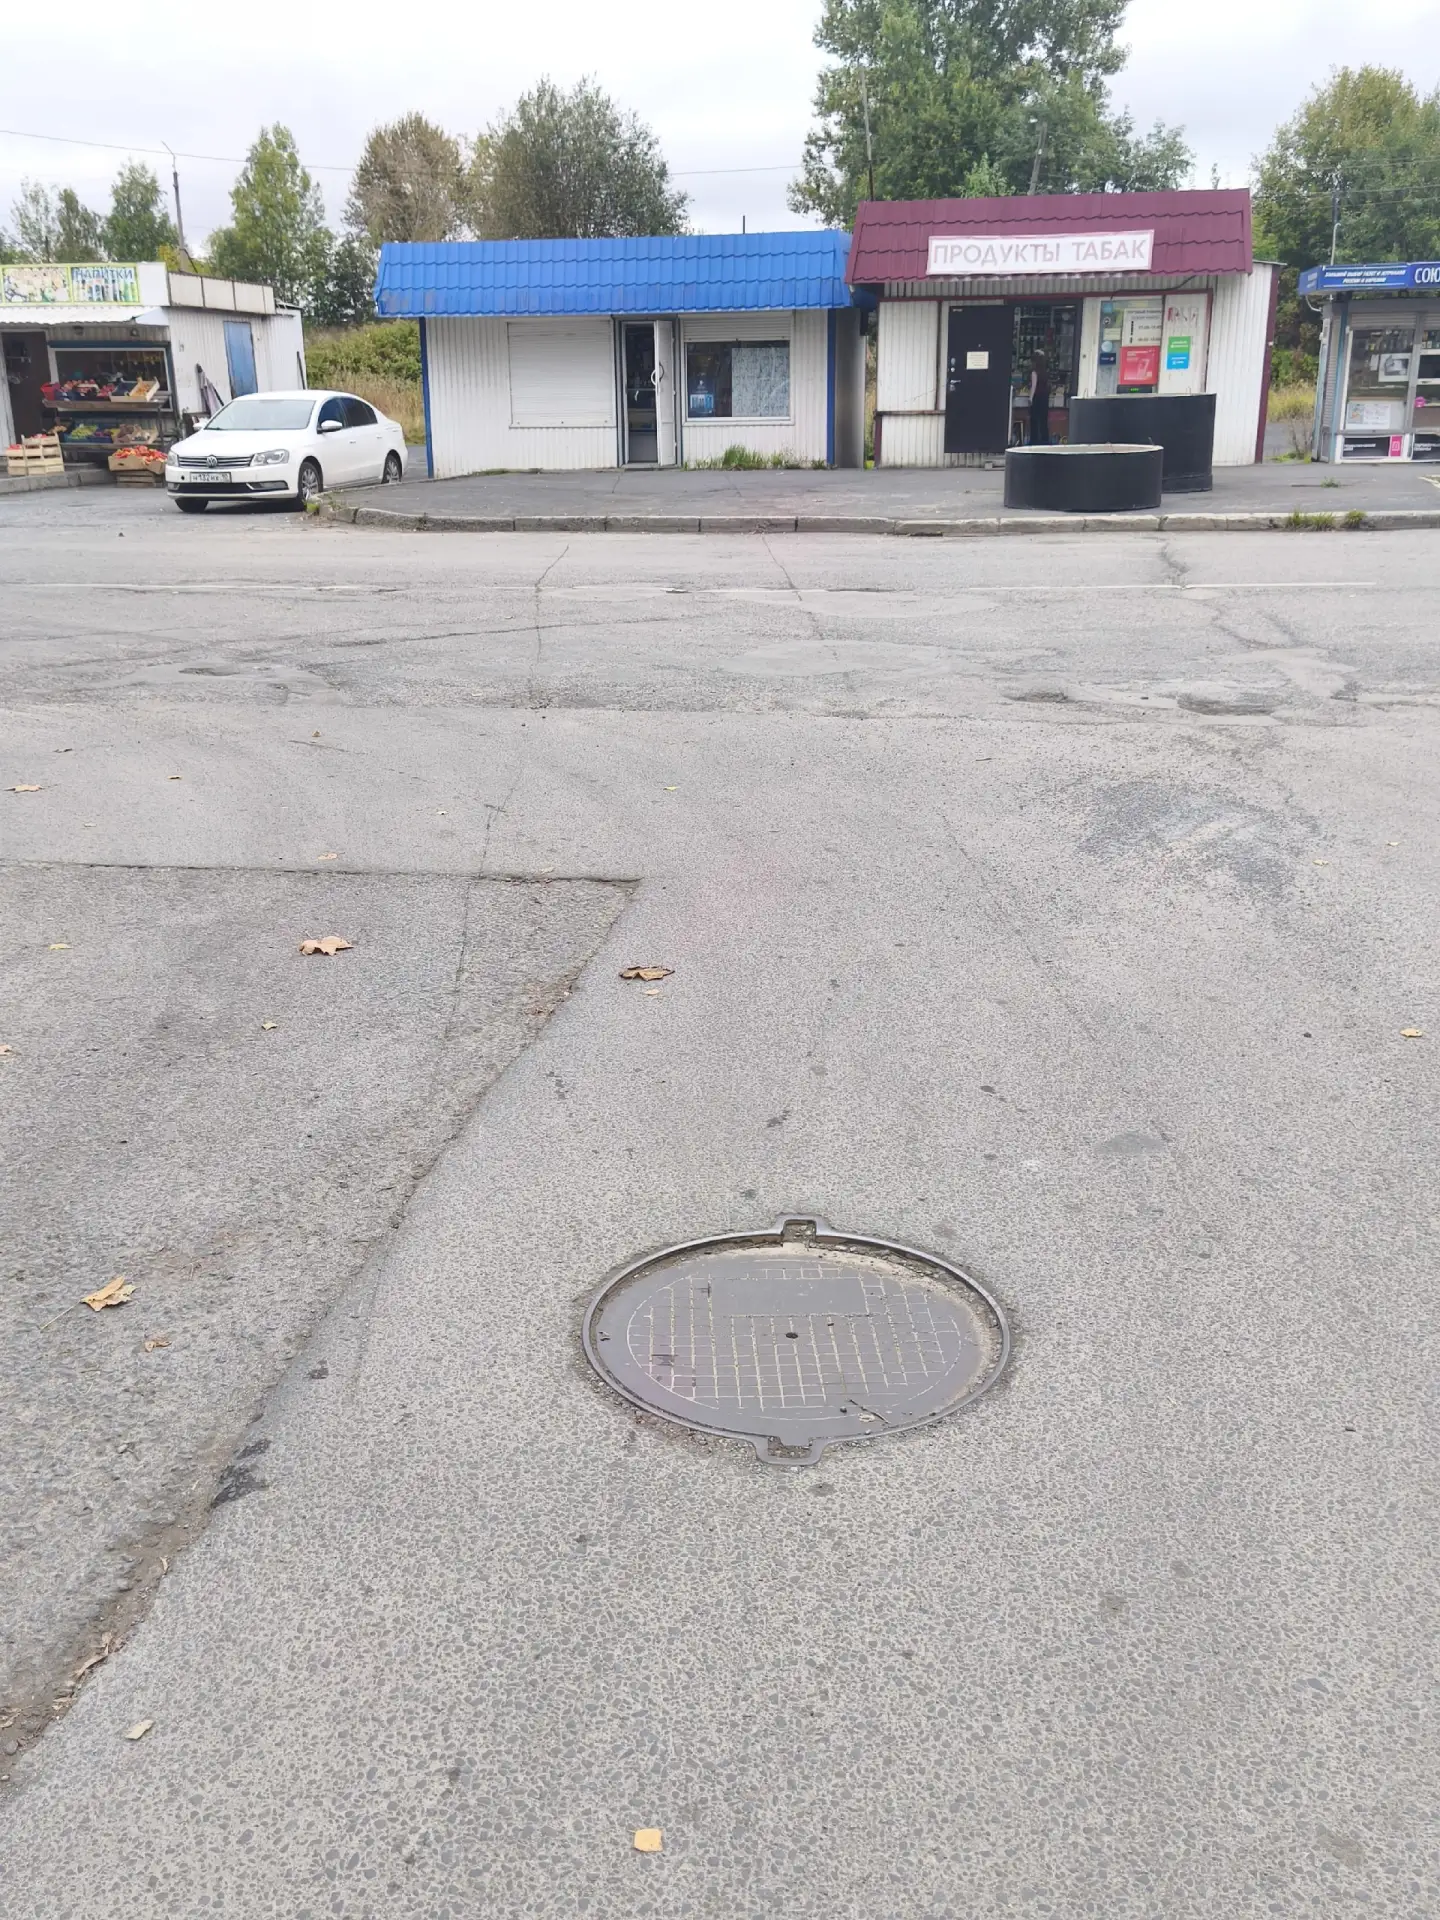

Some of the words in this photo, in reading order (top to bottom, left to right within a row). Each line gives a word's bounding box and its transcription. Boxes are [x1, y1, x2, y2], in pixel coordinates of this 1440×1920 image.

[933, 243, 1060, 266] ПРОДУКТЫ
[1072, 239, 1147, 261] ТАБАК
[75, 269, 133, 279] НАПИТКИ
